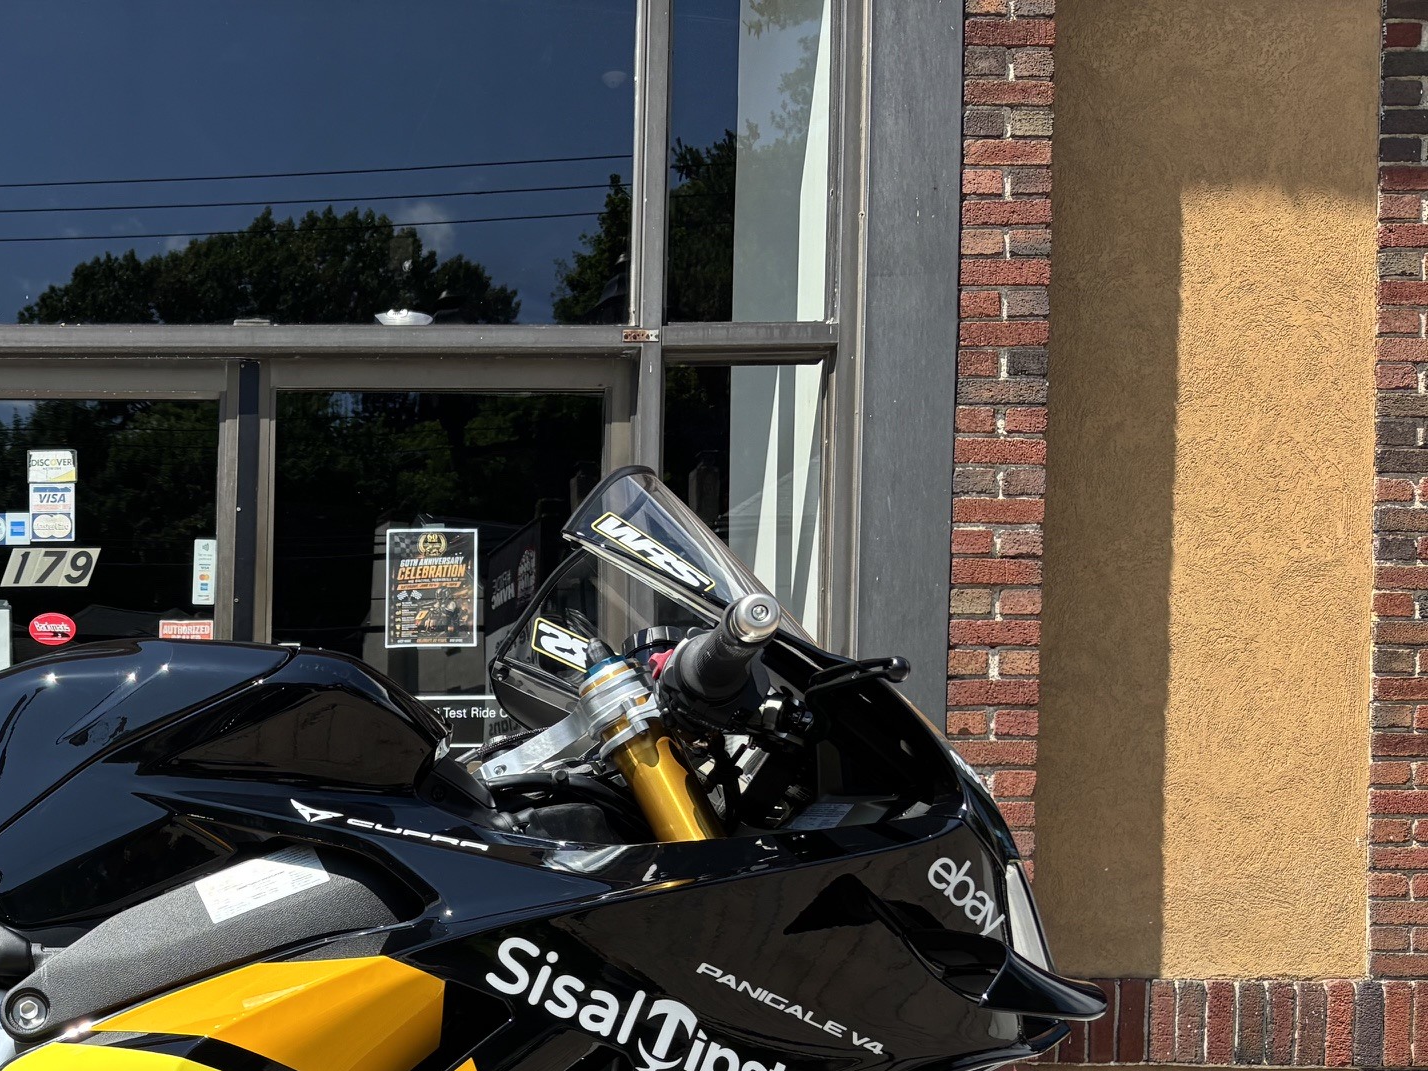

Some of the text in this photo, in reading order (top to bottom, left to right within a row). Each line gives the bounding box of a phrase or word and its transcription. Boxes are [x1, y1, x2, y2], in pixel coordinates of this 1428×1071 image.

[31, 459, 72, 467] DISCOVER
[38, 494, 66, 503] VISA
[12, 550, 93, 584] 179
[418, 556, 464, 566] ANNIVERSARY
[397, 564, 466, 580] CELEBRATION
[443, 707, 467, 718] Test
[470, 706, 496, 718] Ride
[347, 818, 489, 851] CUPRA
[927, 857, 1005, 936] ebay
[696, 962, 884, 1055] PANIGALE V4
